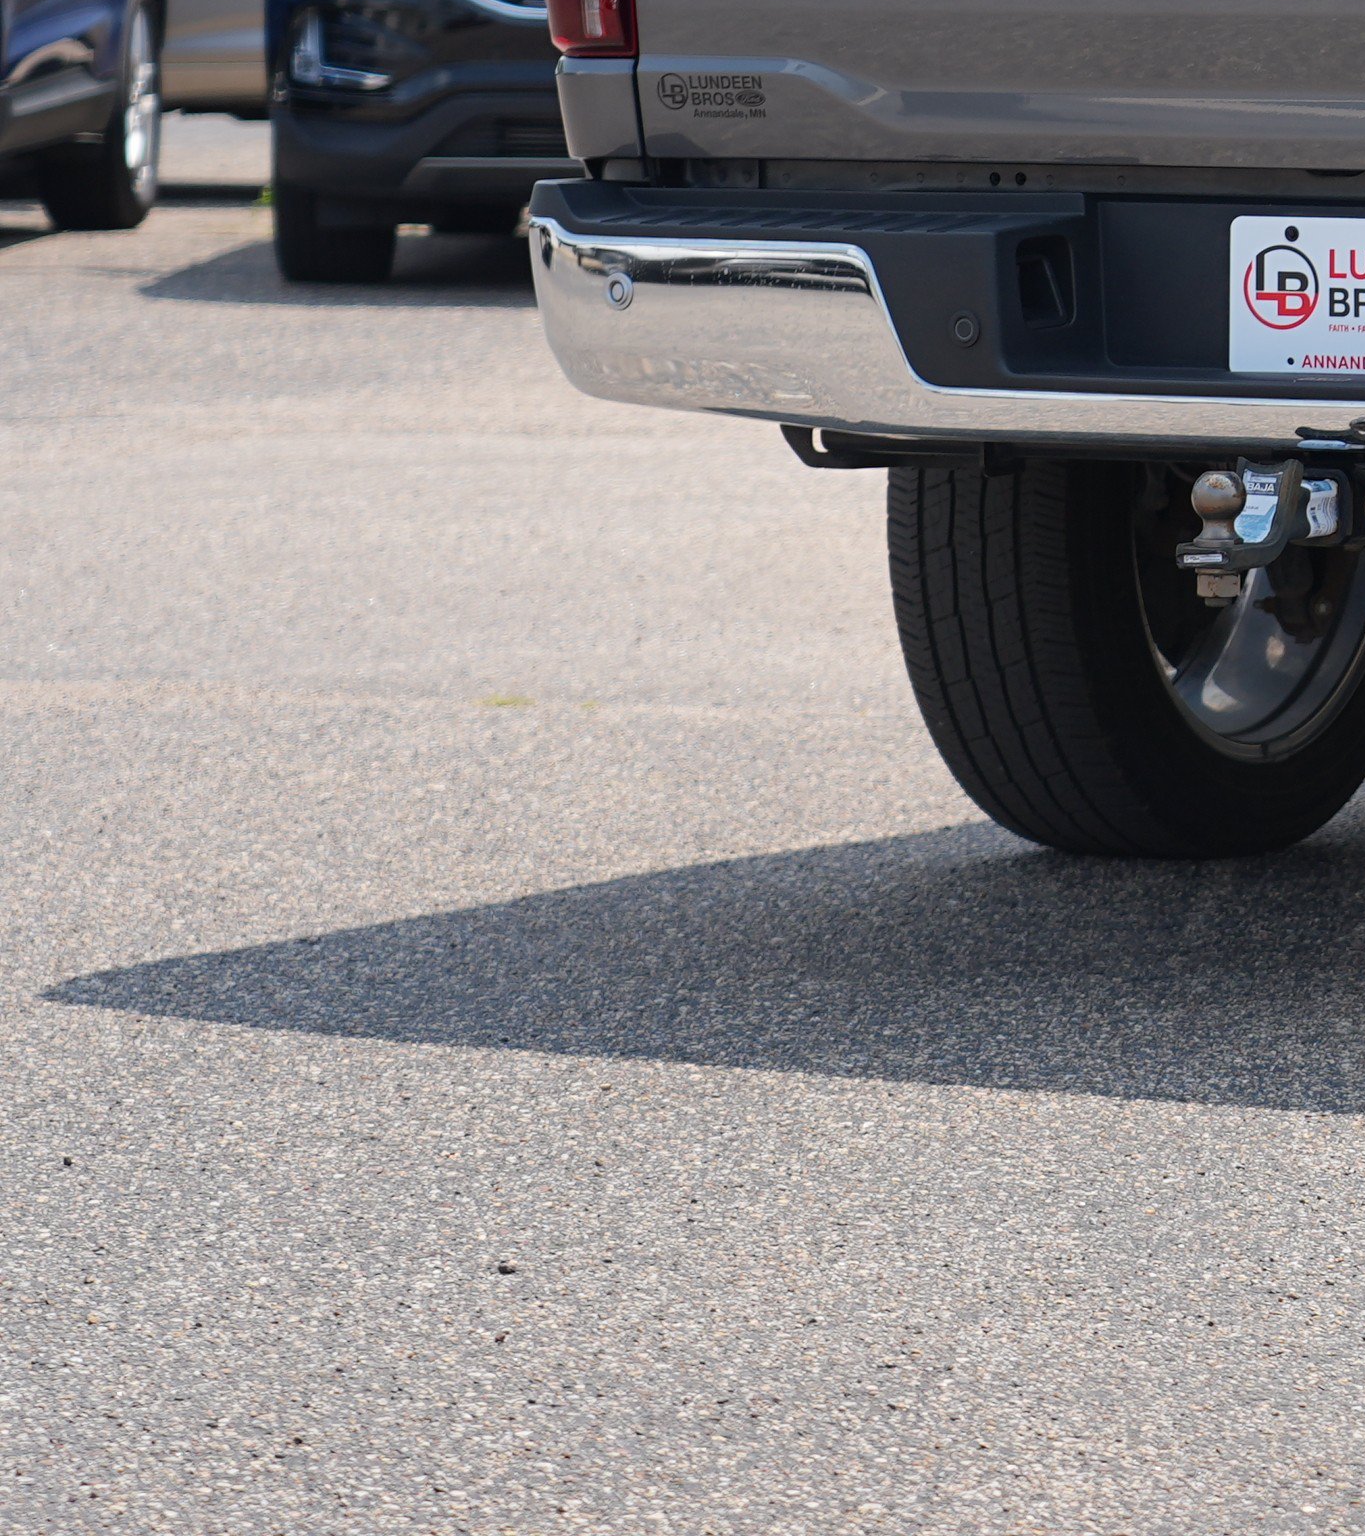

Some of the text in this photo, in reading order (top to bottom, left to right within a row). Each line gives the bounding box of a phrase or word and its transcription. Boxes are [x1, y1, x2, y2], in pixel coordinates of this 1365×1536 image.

[689, 75, 762, 89] LUNDEEN
[691, 92, 735, 106] BROS
[694, 109, 766, 119] Annandale, MN
[1329, 324, 1349, 333] FAITH
[1247, 482, 1275, 492] BAJA
